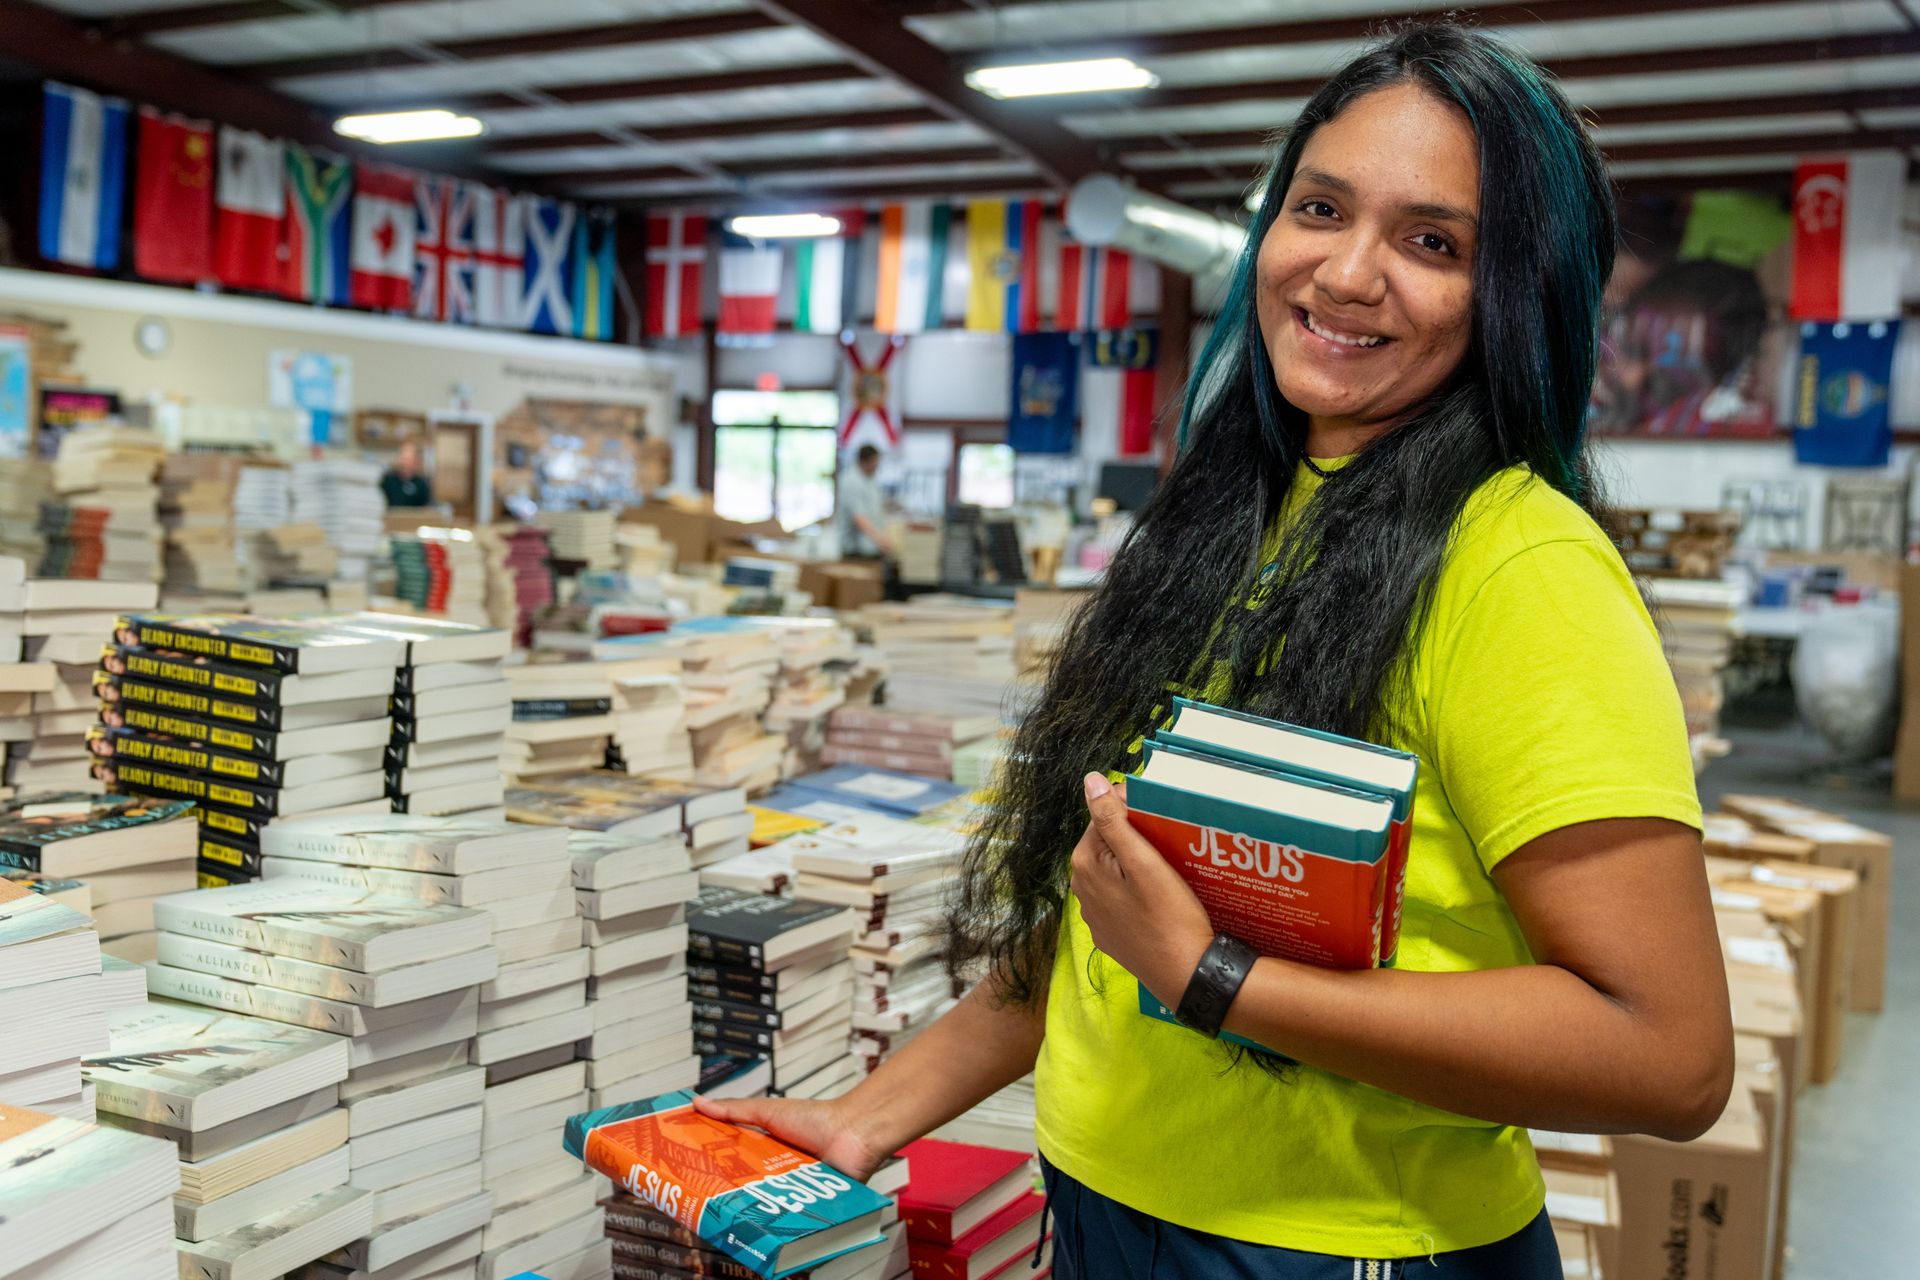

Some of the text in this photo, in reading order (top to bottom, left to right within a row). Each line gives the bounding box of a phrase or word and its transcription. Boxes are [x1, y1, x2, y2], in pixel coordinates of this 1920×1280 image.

[141, 628, 173, 644] DEADLY
[175, 634, 227, 656] ENCOUNTER
[127, 655, 159, 674] DEADLY
[160, 662, 210, 686] ENCOUNTER
[122, 682, 155, 702] DEADLY
[156, 689, 209, 712] ENCOUNTER
[125, 710, 157, 729] DEADLY
[157, 716, 208, 739] ENCOUNTER
[116, 738, 151, 757] DEADLY
[152, 745, 208, 769] ENCOUNTER
[118, 766, 151, 784] DEADLY
[152, 772, 206, 796] ENCOUNTER
[298, 843, 351, 854] ALLIANCE
[1189, 826, 1304, 882] JESUS
[1194, 863, 1218, 874] READY
[1220, 870, 1237, 878] AND
[1238, 875, 1272, 888] WAITING
[1274, 884, 1290, 892] FOR
[1291, 888, 1309, 896] YOU
[1198, 870, 1223, 881] TODAY
[1233, 880, 1251, 888] AND
[1252, 885, 1277, 894] EVERY
[1278, 891, 1296, 900] DAY.
[192, 920, 251, 939] ALLIANCE
[197, 955, 257, 974] ALLIANCE
[179, 983, 238, 1003] ALLIANCE
[622, 1164, 682, 1217] JESUS
[744, 1164, 851, 1214] JESUS
[605, 1212, 669, 1237] seventh day
[613, 1240, 680, 1264] seventh day
